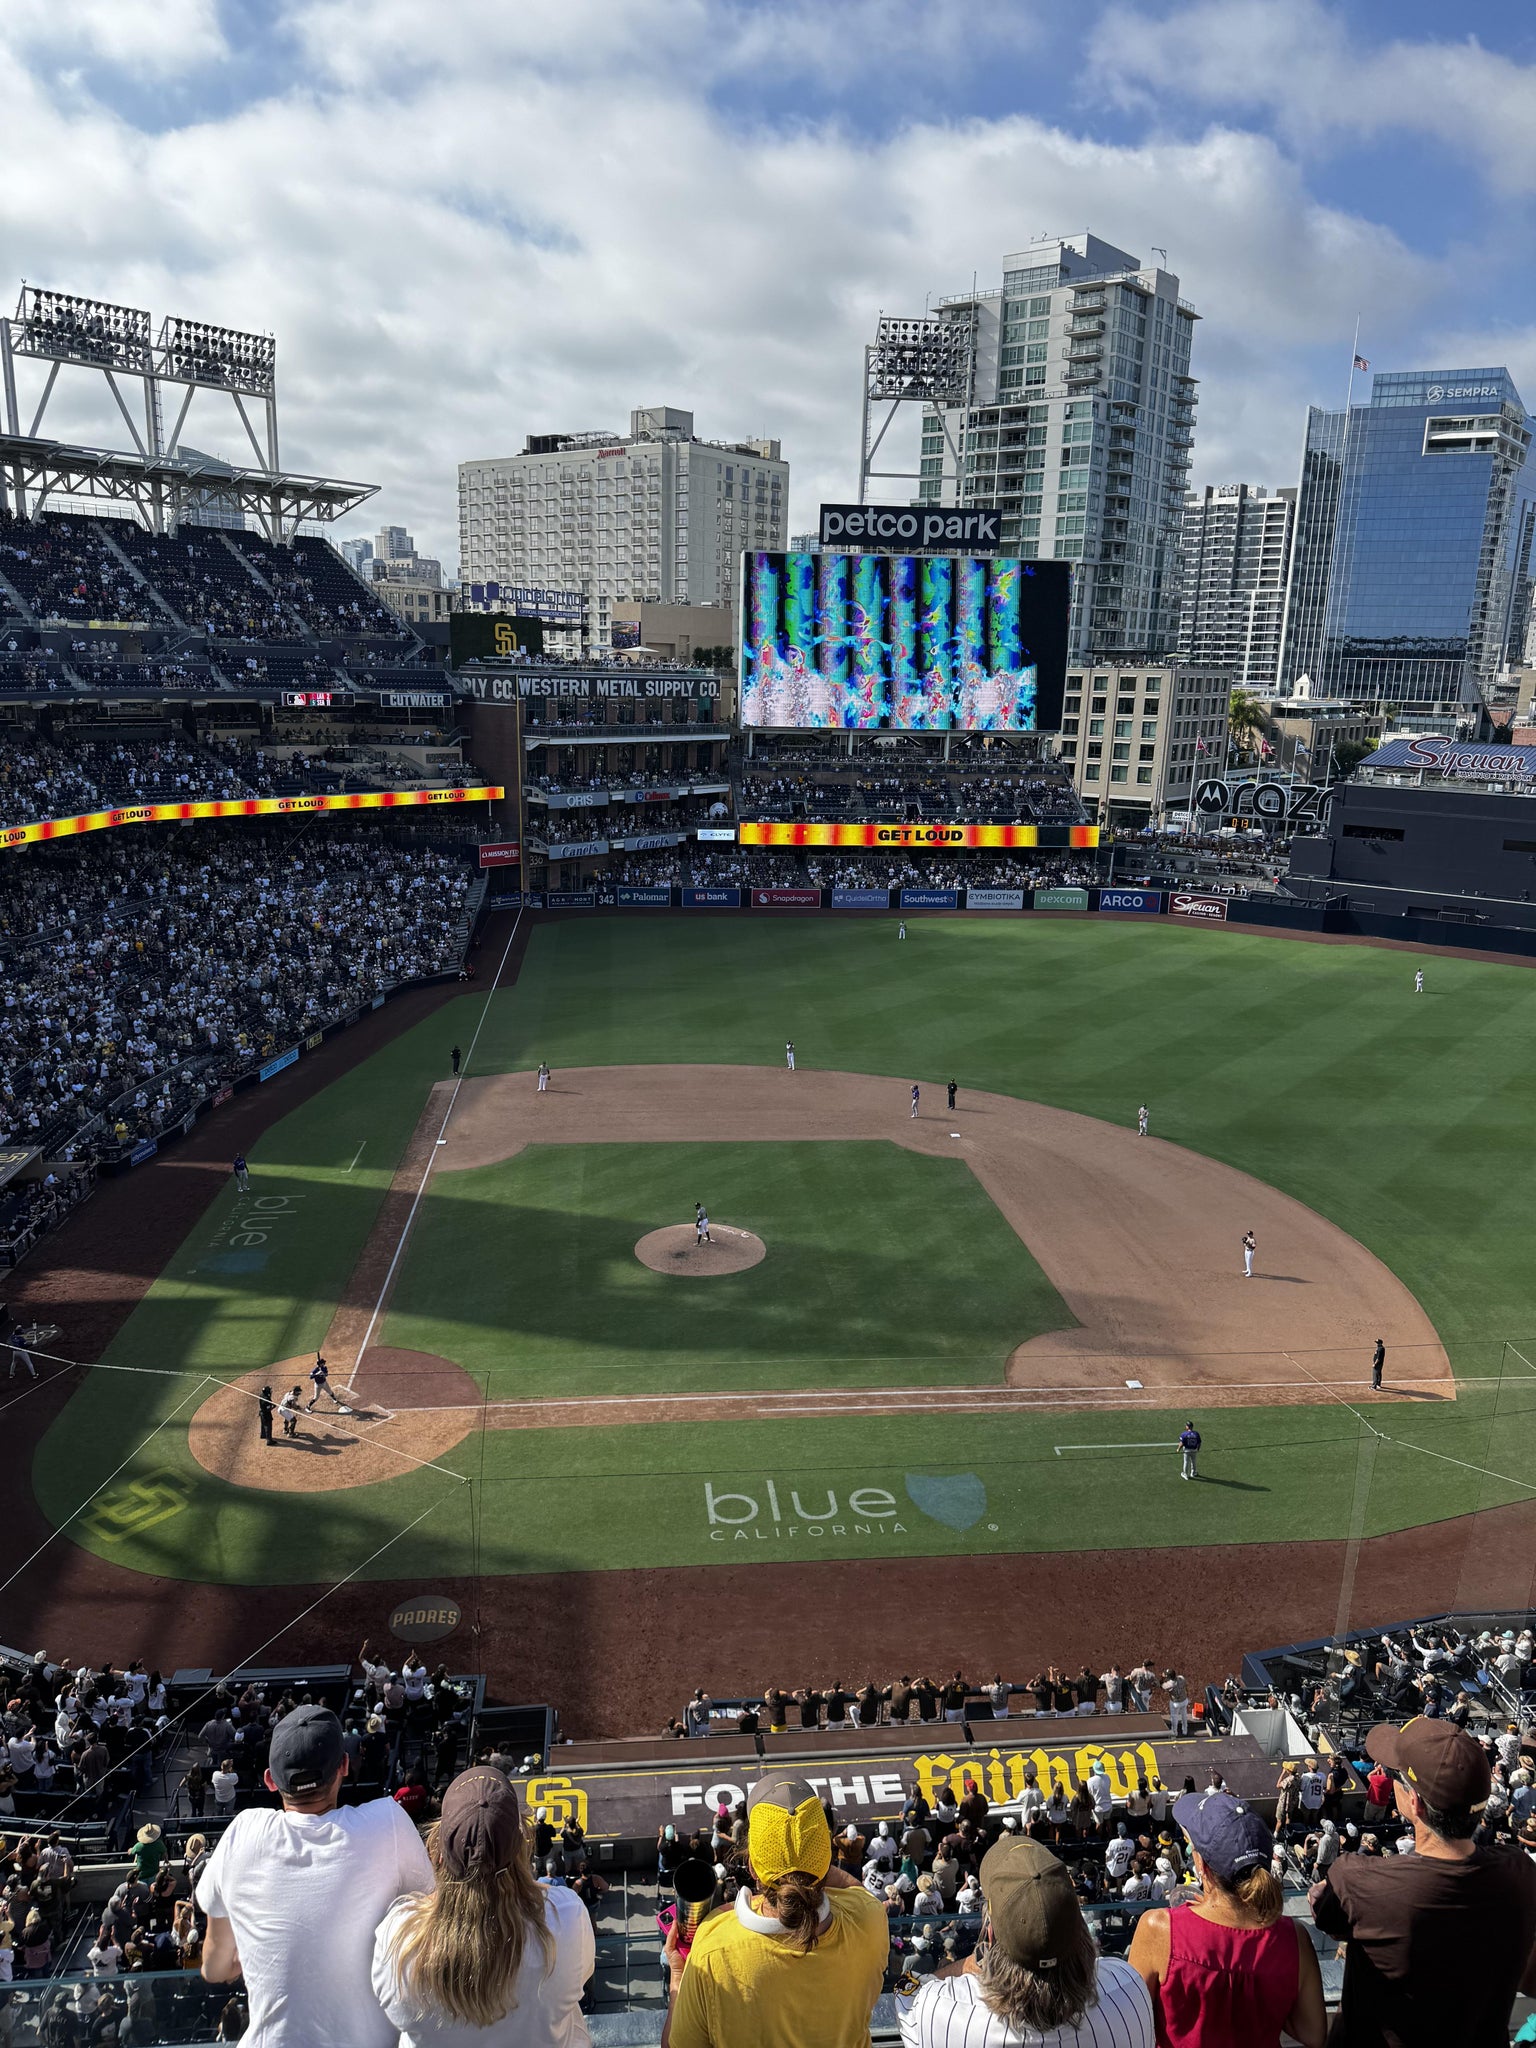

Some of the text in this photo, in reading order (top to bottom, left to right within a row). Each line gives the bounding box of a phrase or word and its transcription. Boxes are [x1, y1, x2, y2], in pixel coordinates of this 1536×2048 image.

[1446, 386, 1498, 398] SEMPRA
[823, 507, 997, 545] petco park
[492, 679, 516, 700] CO.
[519, 678, 720, 697] WESTERN METAL SUPPLY CO.
[389, 694, 444, 706] CUTWATER
[1404, 736, 1529, 777] Sycuan
[443, 792, 465, 800] LOUD
[566, 795, 593, 807] ORIS
[1232, 782, 1334, 821] razr
[278, 800, 324, 809] GET LOUD
[113, 810, 152, 821] GET LOUD
[4, 831, 26, 842] LOUD
[878, 830, 963, 841] GET LOUD
[530, 855, 543, 865] 336
[598, 895, 614, 904] 342
[633, 893, 668, 901] Palomar
[772, 895, 814, 903] Snapdragon
[904, 895, 947, 903] Southwest
[1101, 895, 1143, 907] ARCO
[1173, 896, 1220, 914] Sycuan
[704, 1480, 897, 1525] blue
[710, 1522, 908, 1541] CALIFORNIA
[391, 1609, 458, 1628] PADRES
[671, 1782, 757, 1815] FO
[1116, 1853, 1128, 1864] 21
[869, 1873, 884, 1889] 23
